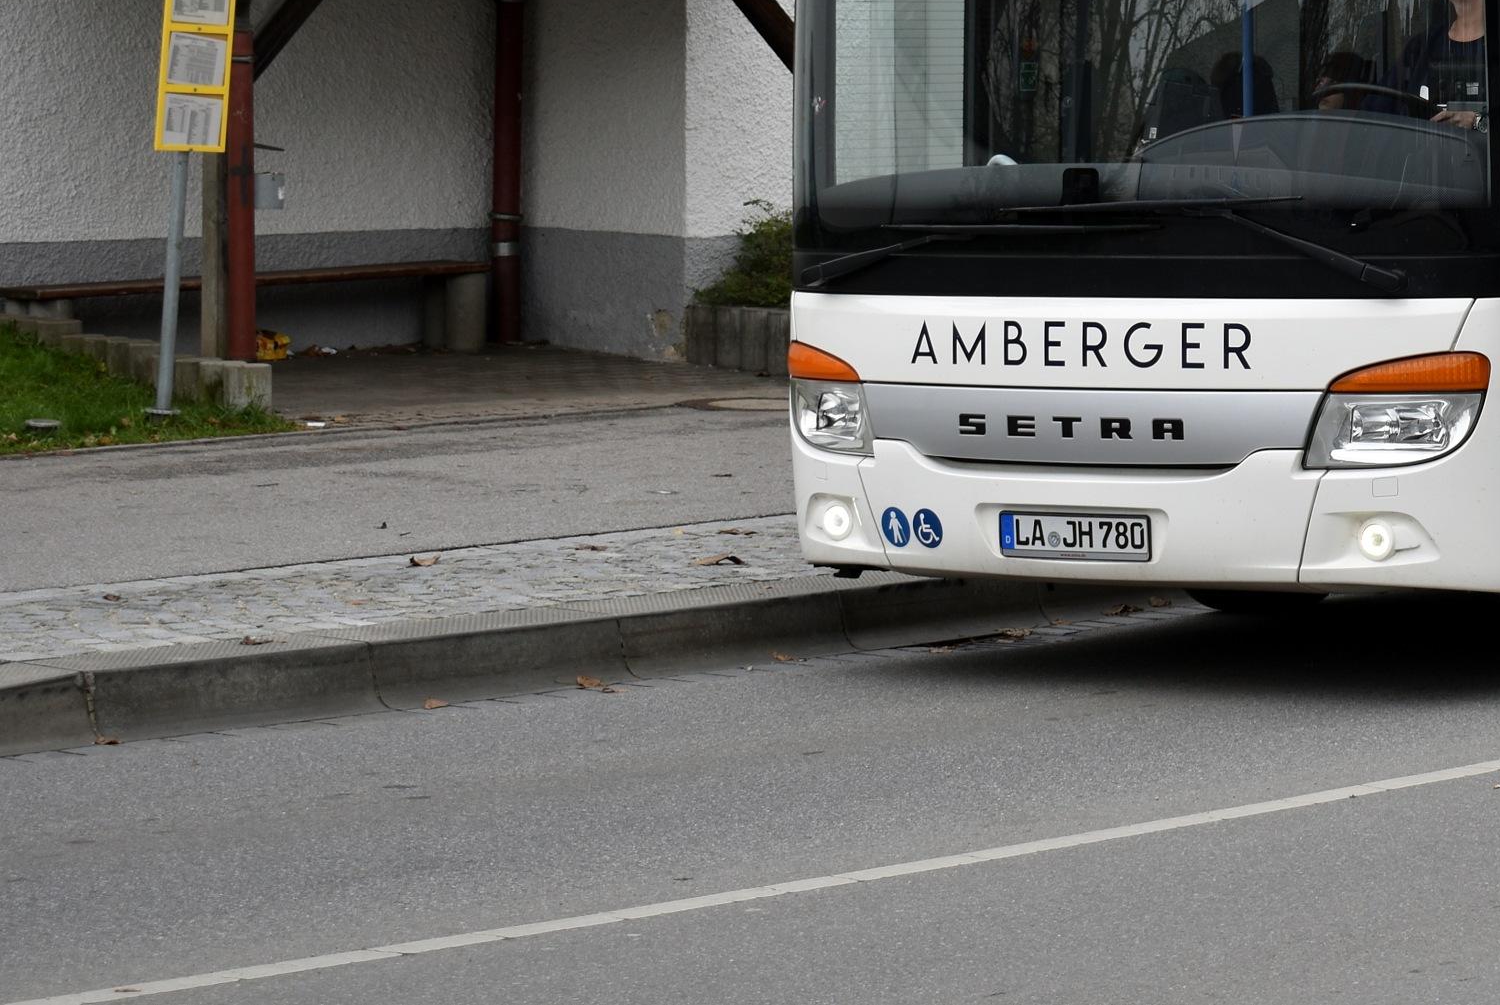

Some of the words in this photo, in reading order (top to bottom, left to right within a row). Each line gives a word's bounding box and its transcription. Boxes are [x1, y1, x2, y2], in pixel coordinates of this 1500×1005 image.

[911, 320, 1252, 369] AMBERGER
[959, 413, 1185, 441] SETRA
[1015, 518, 1045, 546] LA
[1062, 520, 1093, 548] JH
[1099, 521, 1145, 549] 780
